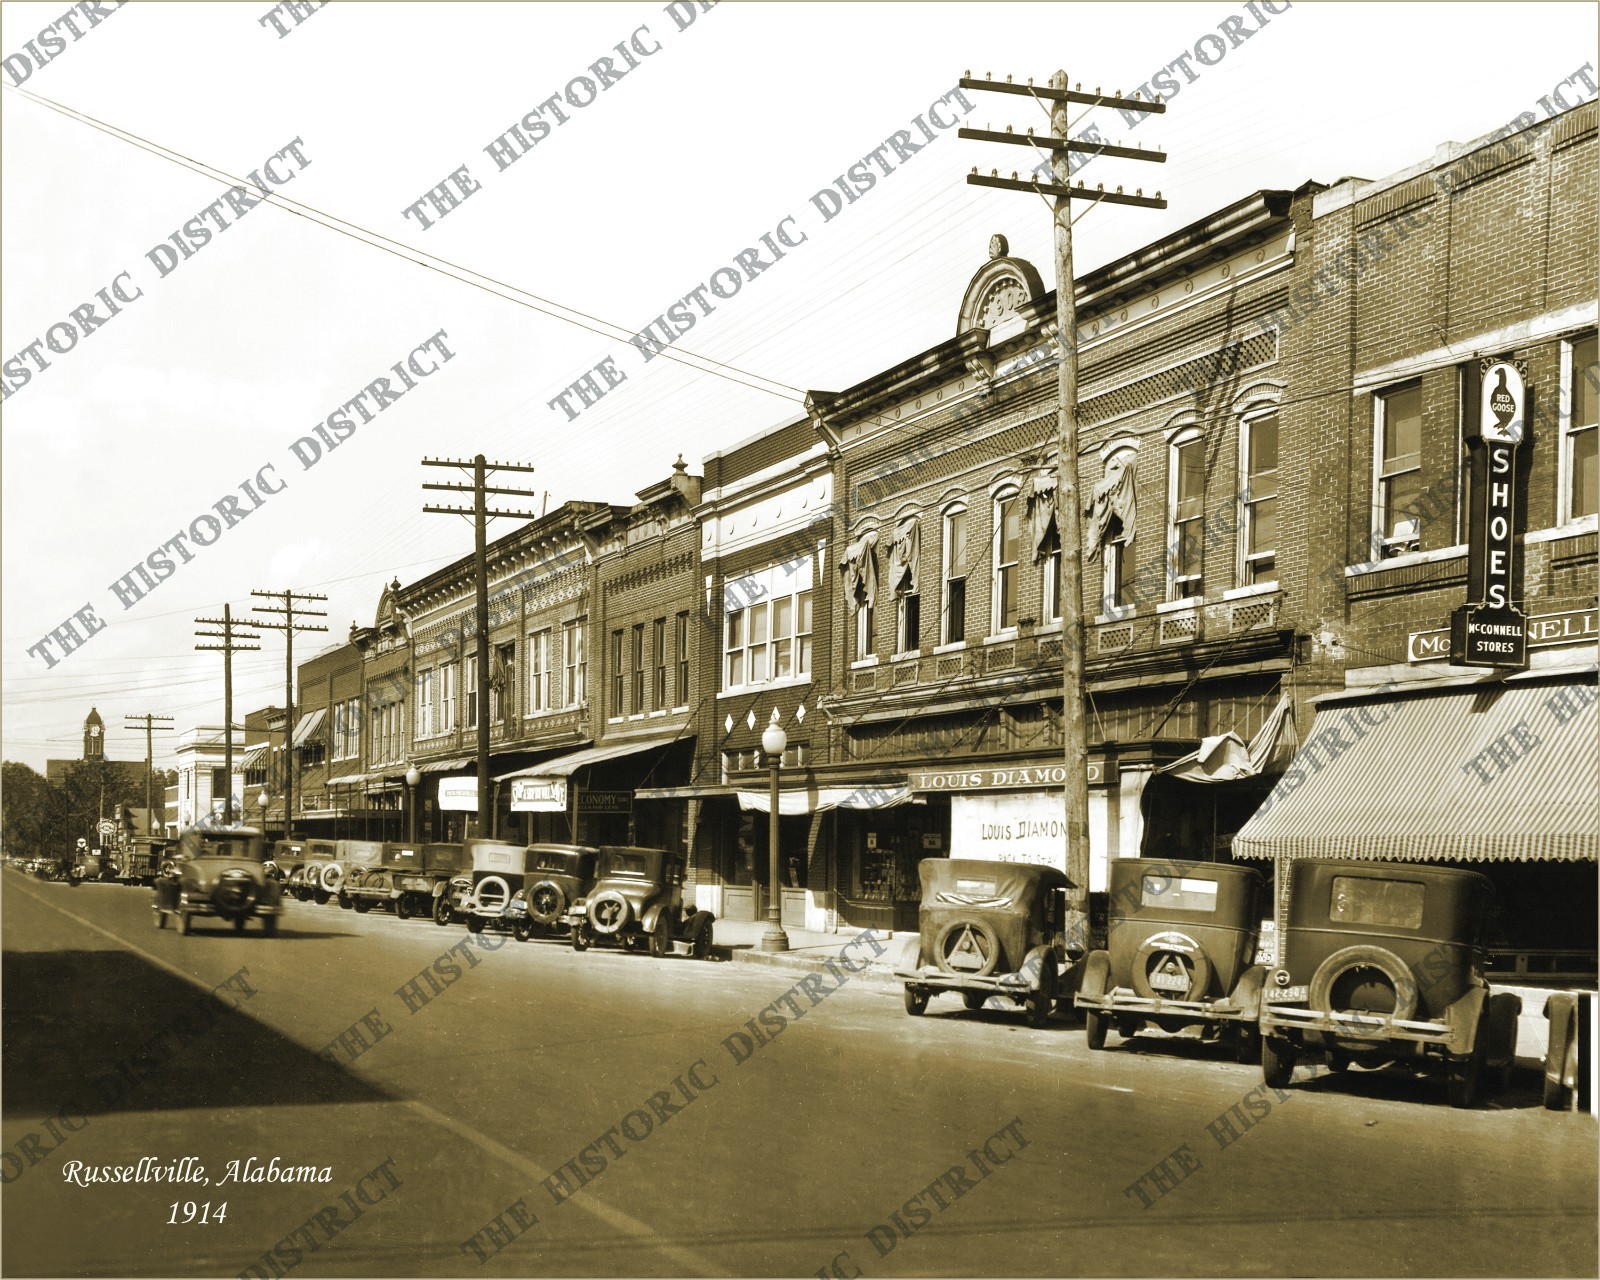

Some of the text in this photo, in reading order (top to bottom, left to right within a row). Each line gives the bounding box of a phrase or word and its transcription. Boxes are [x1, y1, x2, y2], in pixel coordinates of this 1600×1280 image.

[1496, 394, 1510, 404] RED
[1492, 403, 1515, 413] GOOSE
[1489, 449, 1510, 609] SHOES
[1477, 641, 1514, 653] STORES
[919, 765, 1100, 789] LOUIS DIAMOD
[982, 824, 1012, 840] LOUIS
